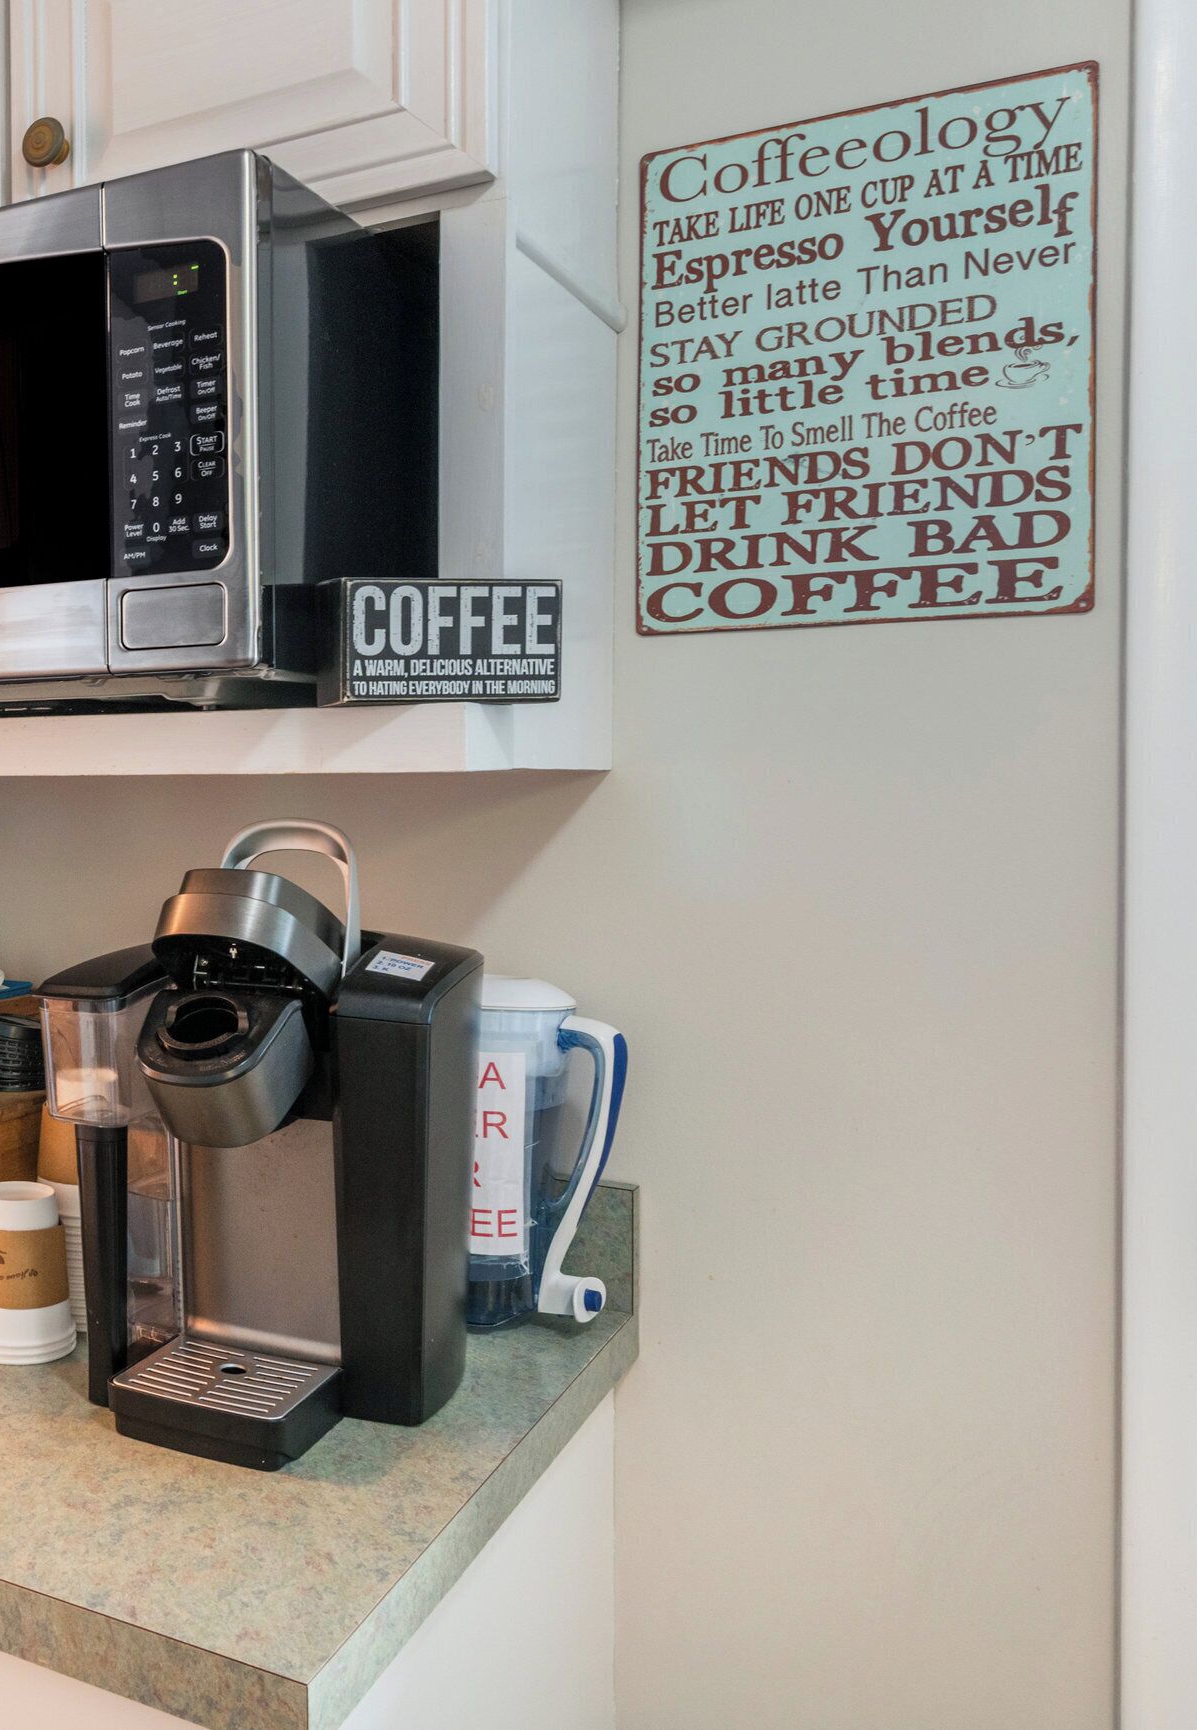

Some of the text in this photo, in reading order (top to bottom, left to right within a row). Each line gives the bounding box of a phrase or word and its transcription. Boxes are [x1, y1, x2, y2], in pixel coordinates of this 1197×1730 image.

[659, 97, 1071, 202] Coffeeology
[653, 142, 1083, 247] TAKE LIFE ONE CUP AT A TIME
[652, 183, 1079, 294] Espresso Yourself
[654, 240, 1076, 328] Better latte Than Never
[165, 320, 186, 328] Cooking
[649, 294, 997, 368] STAY GROUNDED
[194, 332, 218, 341] Reheat
[154, 339, 183, 349] Beverage
[120, 347, 144, 356] Popcorn
[652, 316, 1080, 397] so many blends,
[192, 354, 221, 365] Chicken/
[155, 364, 182, 374] Vegetable
[122, 372, 143, 380] Potato
[197, 380, 216, 388] Timer
[157, 386, 181, 395] Defrost
[648, 365, 989, 428] so little time
[125, 400, 141, 408] Cook
[196, 406, 218, 414] Beeper
[119, 420, 147, 430] Reminder
[647, 401, 997, 464] Take Time To Smell The Coffee
[152, 445, 159, 455] 2
[175, 442, 181, 452] 3
[131, 448, 137, 459] 1
[645, 424, 1082, 500] FRIENDS DON'T
[153, 471, 159, 481] 5
[175, 467, 182, 478] 6
[130, 474, 137, 484] 4
[153, 497, 159, 507] 8
[175, 494, 182, 504] 9
[645, 465, 1072, 537] LET FRIENDS
[131, 499, 137, 510] 7
[199, 515, 218, 523] Delay
[124, 524, 144, 532] Power
[153, 523, 160, 533] 0
[200, 521, 217, 529] Start
[126, 530, 143, 538] Level
[199, 544, 218, 552] Clock
[646, 510, 1071, 576] DRINK BAD
[124, 552, 146, 560] AM/PM
[646, 557, 1065, 623] COFFEE
[354, 585, 556, 656] COFFEE
[353, 659, 555, 678] A WARM, DELICIOUS ALTERNATIVE
[353, 680, 555, 695] TO HATING EVERYBODY IN THE MORNING
